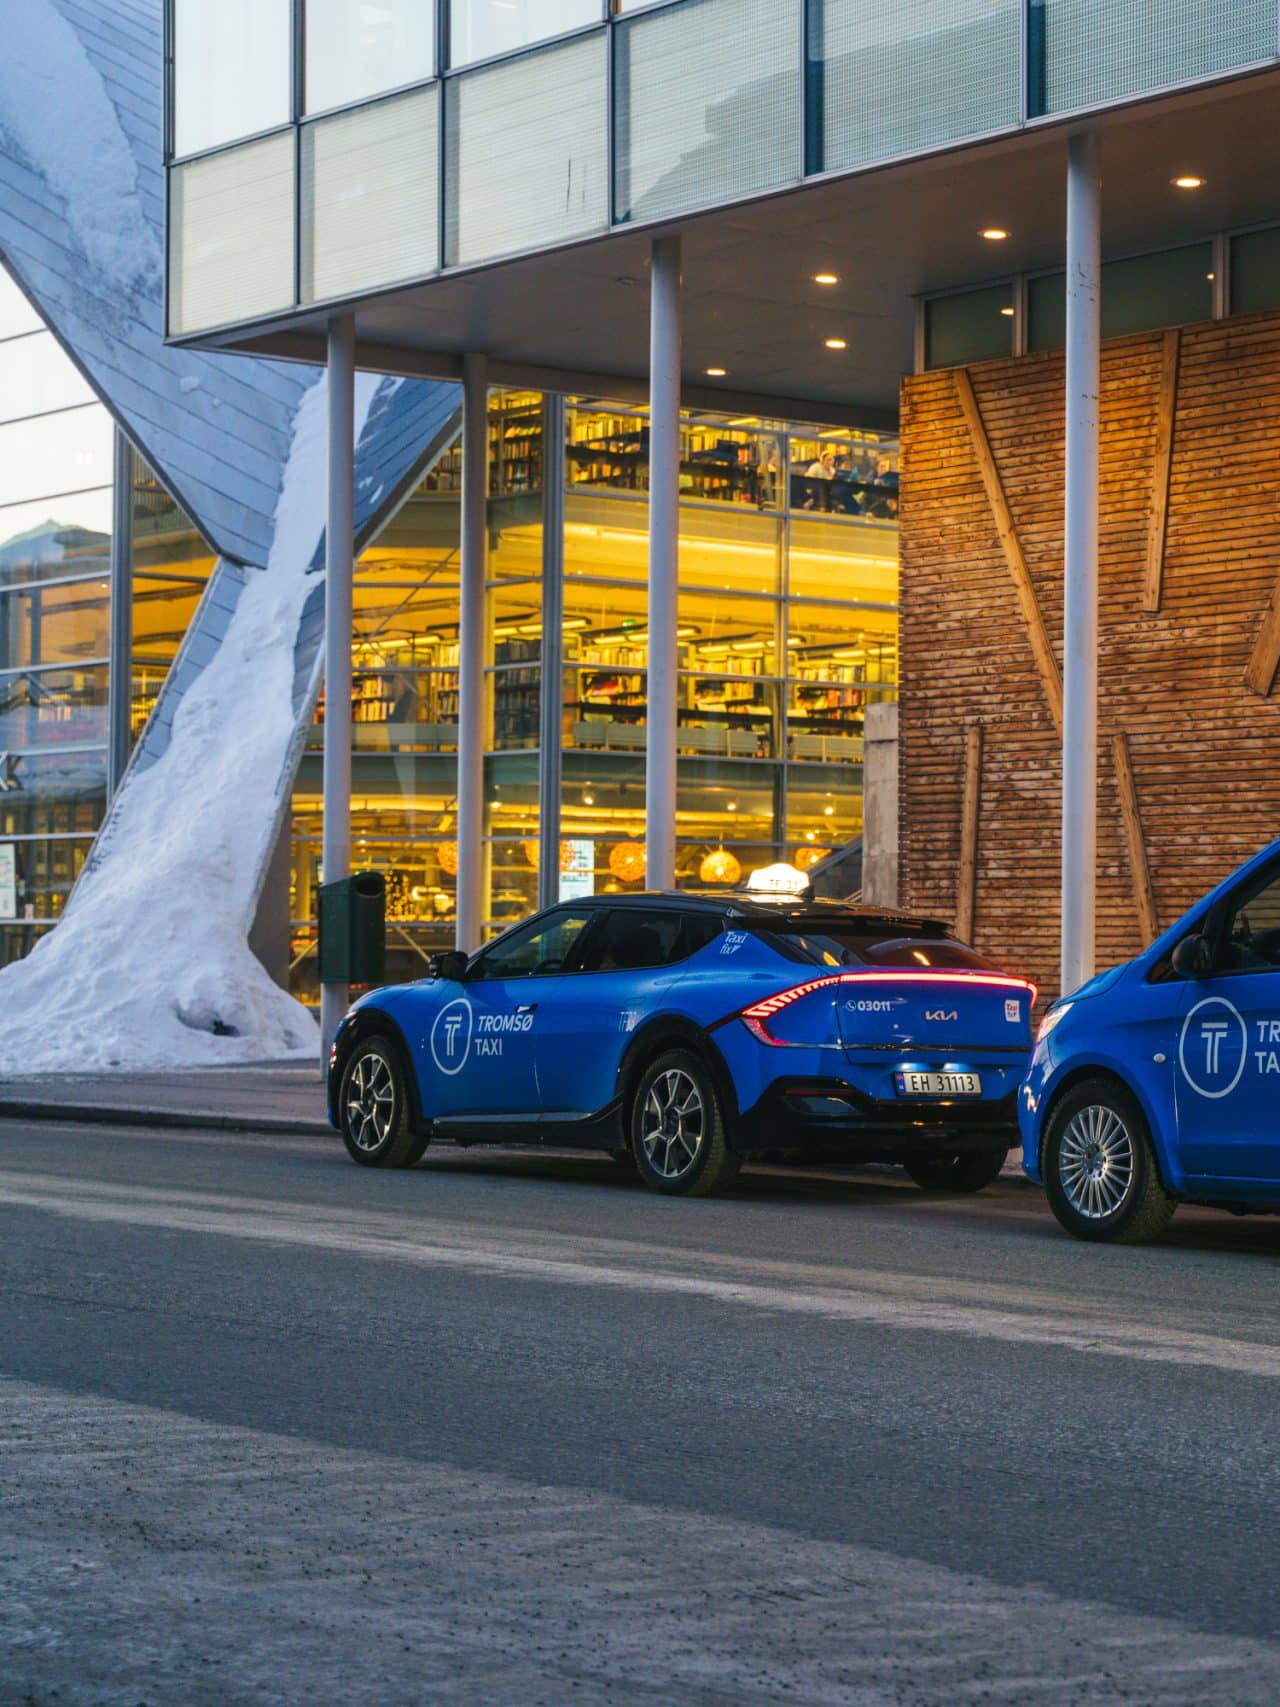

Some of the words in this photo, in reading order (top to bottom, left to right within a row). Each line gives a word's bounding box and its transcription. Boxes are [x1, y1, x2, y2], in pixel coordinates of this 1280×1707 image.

[725, 931, 749, 944] Taxi
[857, 1001, 891, 1012] 03011
[477, 1012, 534, 1033] TROMSØ
[925, 1010, 958, 1021] KIA
[474, 1037, 504, 1056] TAXI
[910, 1076, 930, 1091] EH
[937, 1075, 975, 1091] 31113
